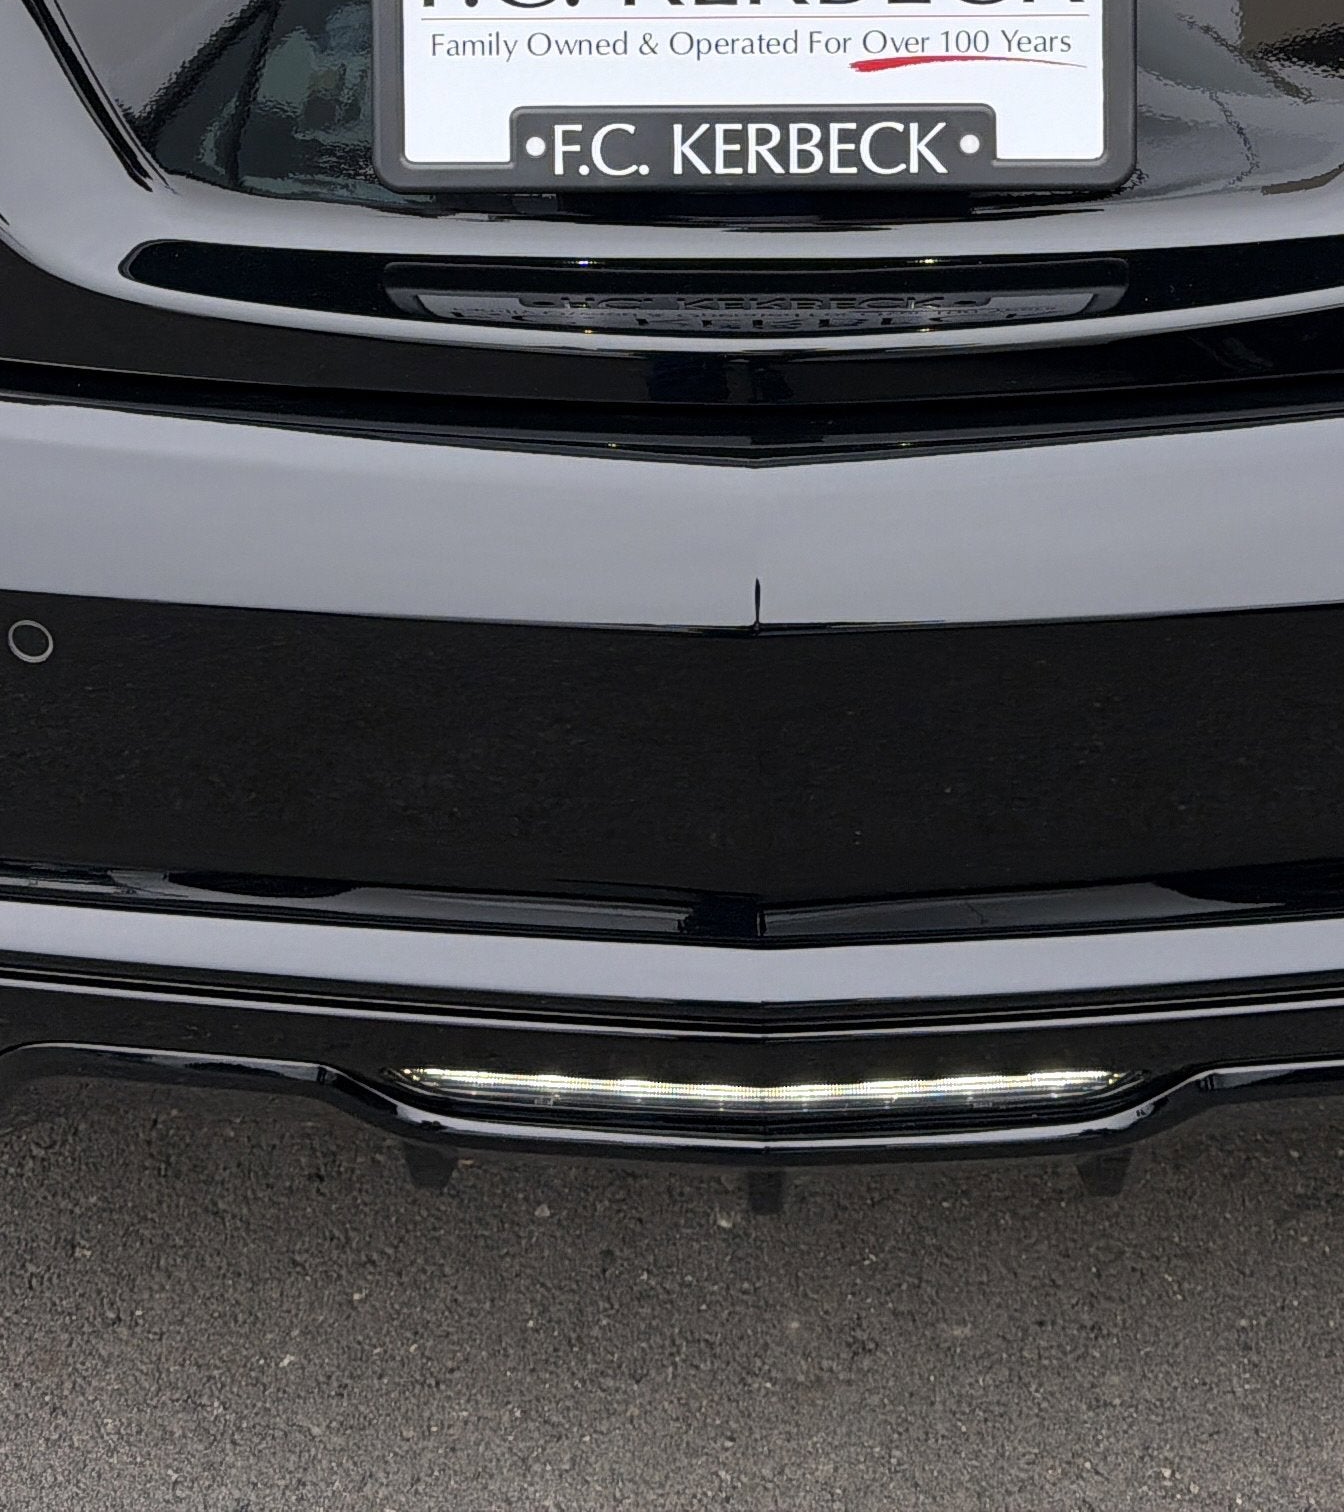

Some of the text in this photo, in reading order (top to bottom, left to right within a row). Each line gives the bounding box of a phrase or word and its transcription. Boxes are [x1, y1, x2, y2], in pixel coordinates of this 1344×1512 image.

[431, 29, 1072, 62] Family Owned & Operated For Over 100 Years
[553, 121, 948, 175] F.C. KERBECK
